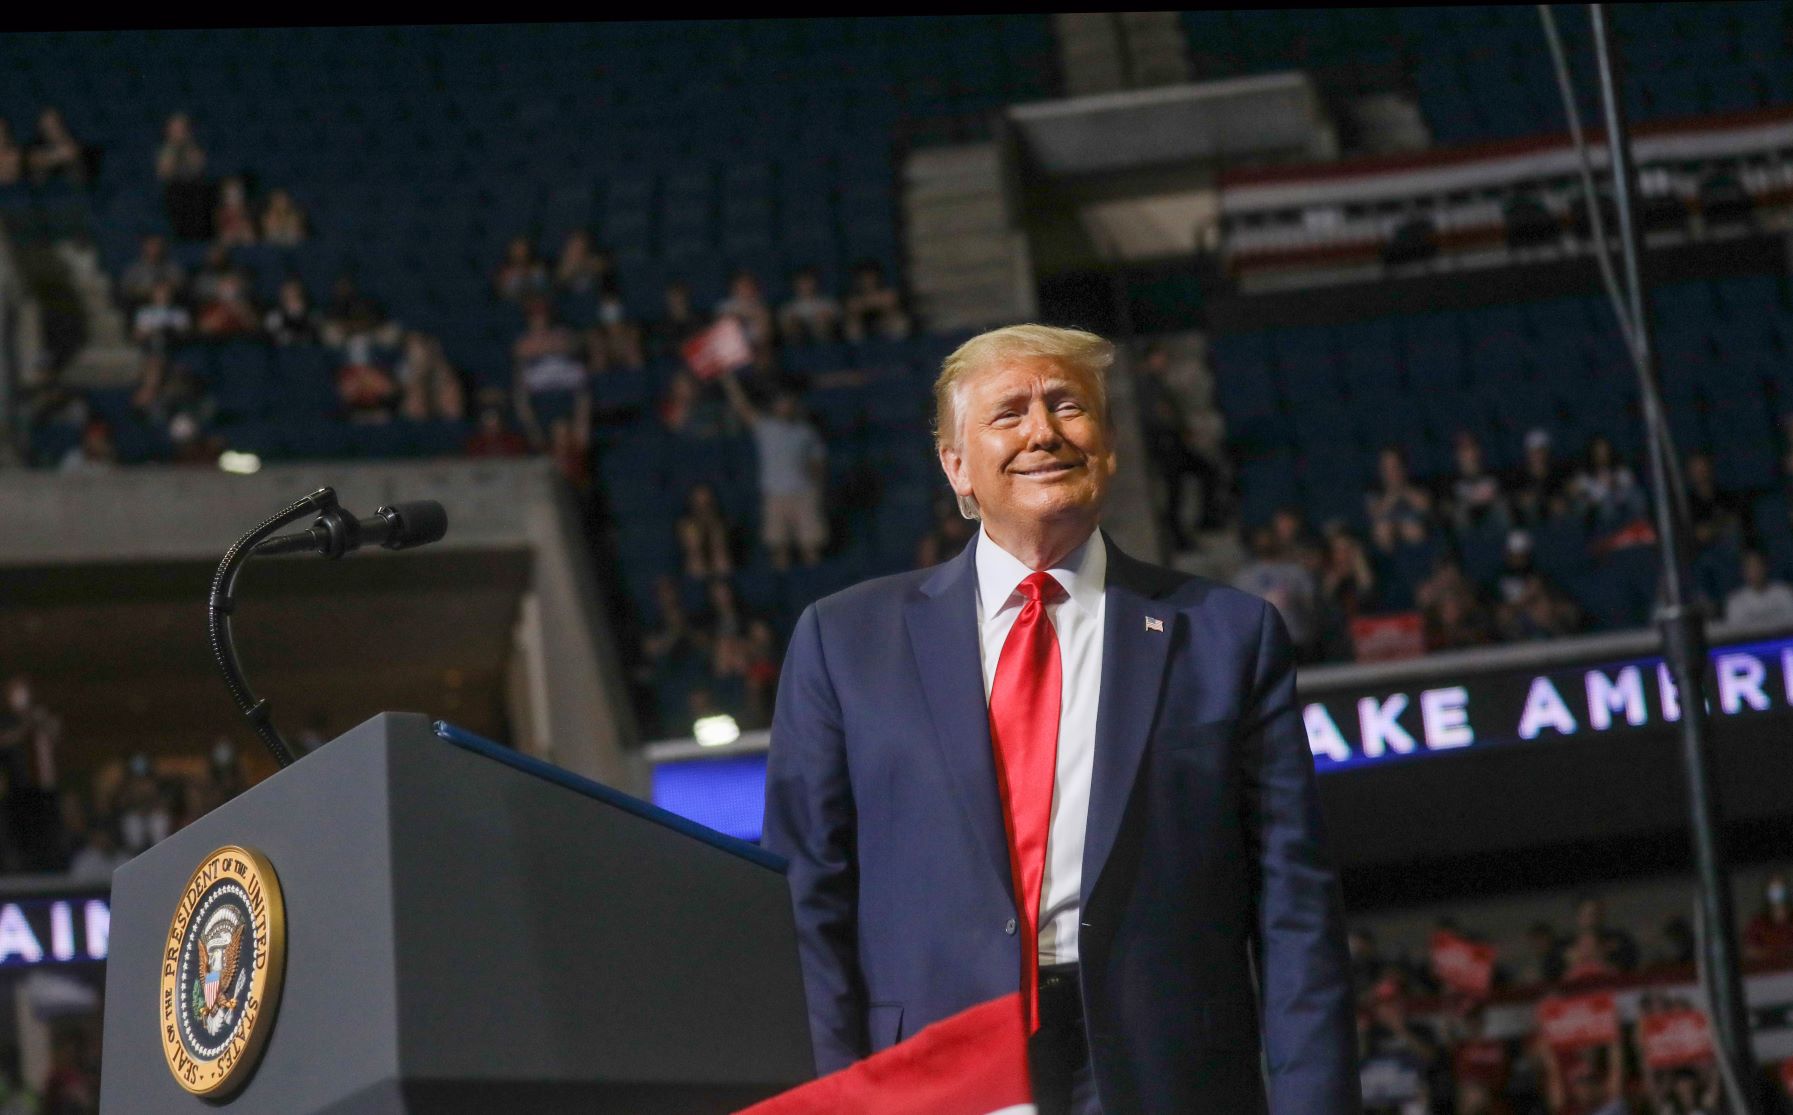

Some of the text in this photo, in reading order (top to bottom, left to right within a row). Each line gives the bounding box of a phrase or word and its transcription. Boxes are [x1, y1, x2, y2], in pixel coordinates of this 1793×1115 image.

[222, 857, 234, 872] OF
[234, 858, 248, 879] THE
[164, 857, 220, 977] PRESIDENT
[248, 873, 267, 970] UNITED
[165, 988, 173, 1021] THE
[166, 1023, 175, 1043] OF
[216, 996, 259, 1078] STATES
[172, 1041, 199, 1085] SEAL
